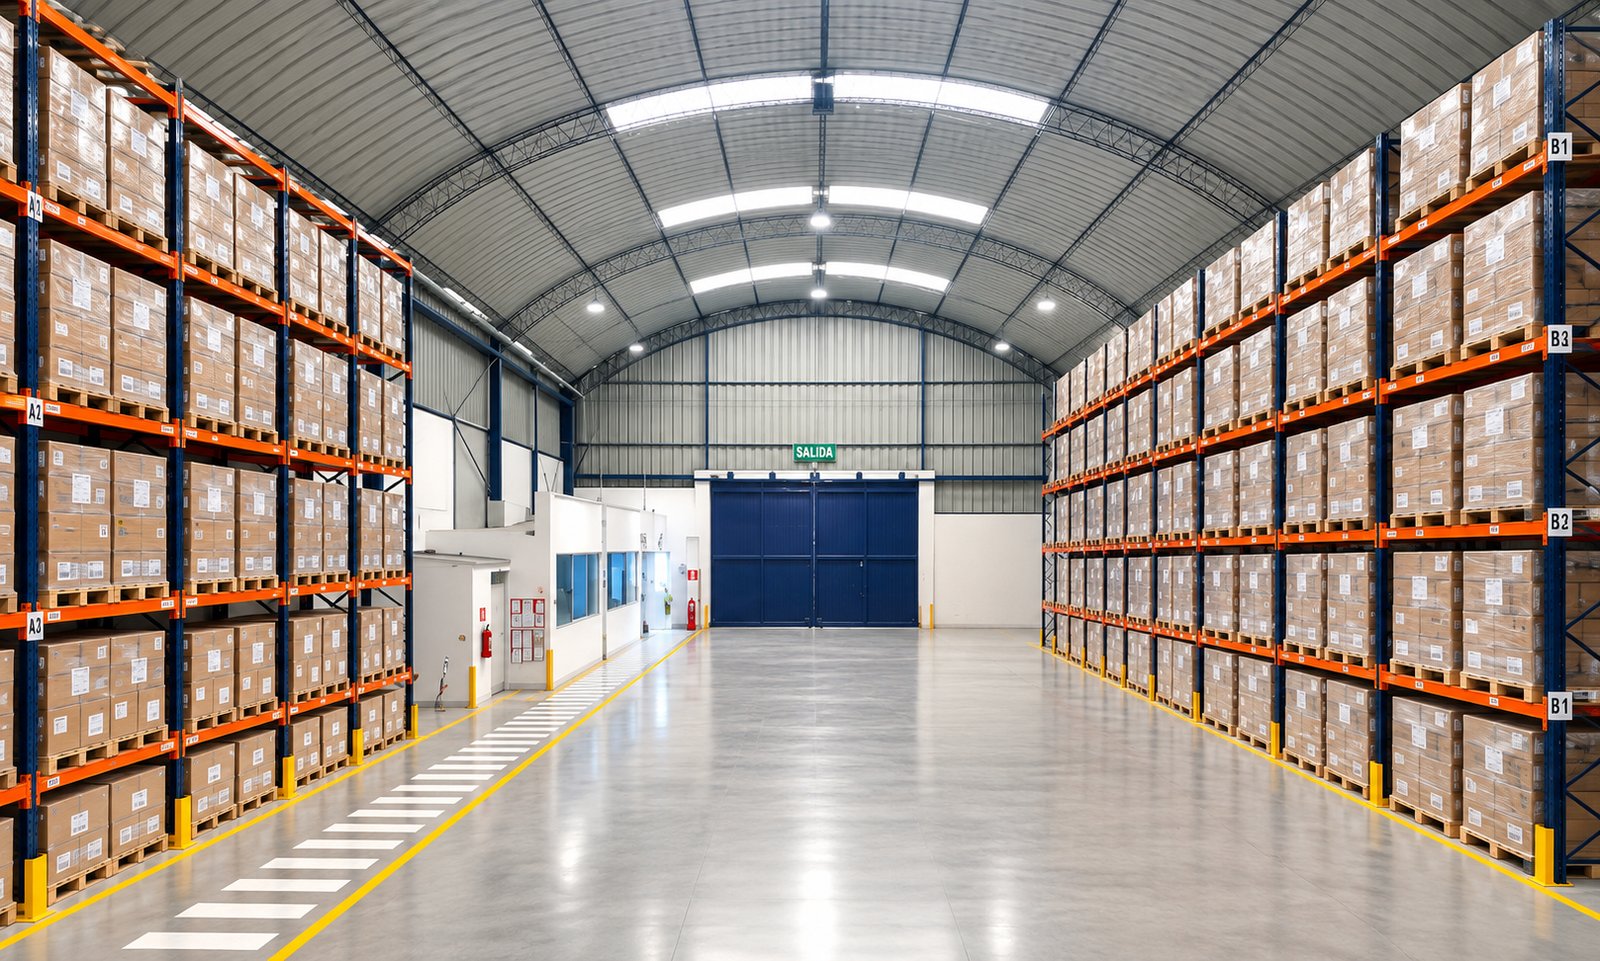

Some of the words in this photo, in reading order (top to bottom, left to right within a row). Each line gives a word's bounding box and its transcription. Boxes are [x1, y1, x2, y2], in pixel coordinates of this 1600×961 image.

[1551, 138, 1567, 154] B1
[29, 403, 41, 421] A2
[796, 446, 833, 458] SALIDA
[1551, 697, 1567, 714] B1
